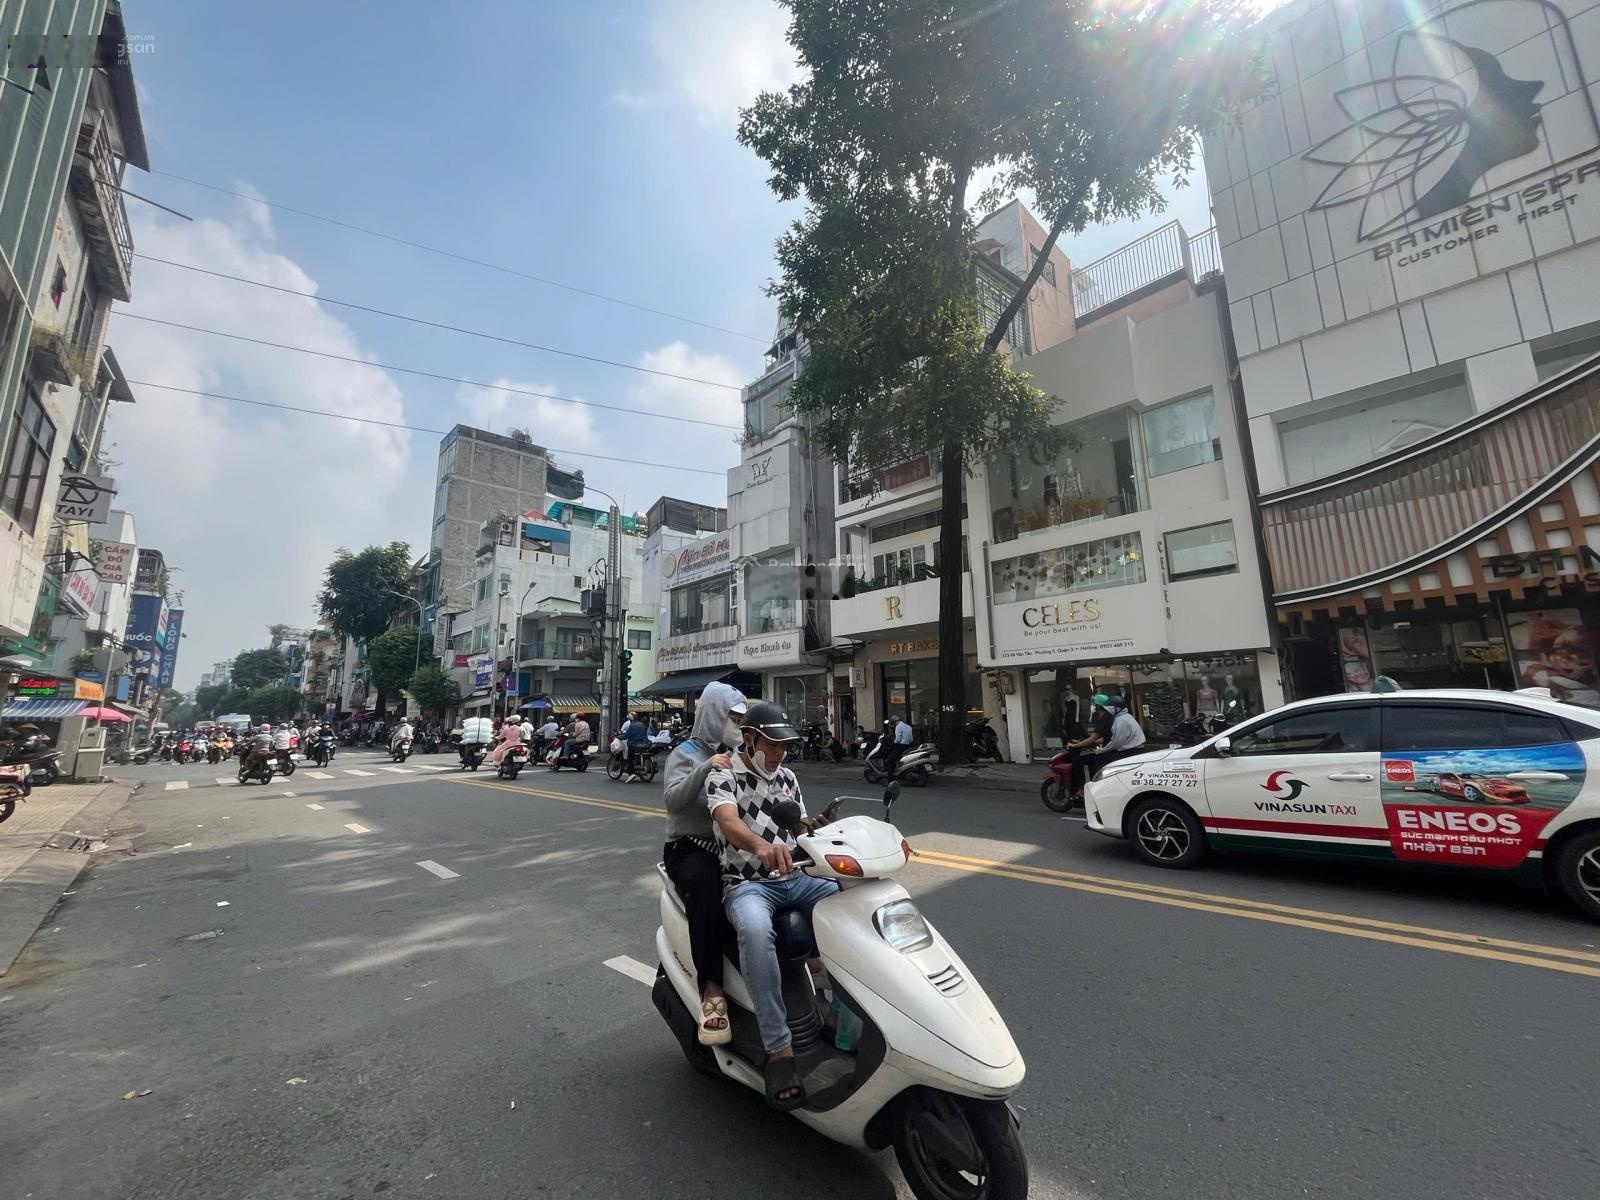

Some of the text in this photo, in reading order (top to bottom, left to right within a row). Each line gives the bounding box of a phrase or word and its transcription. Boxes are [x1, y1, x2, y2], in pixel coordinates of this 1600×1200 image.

[1397, 194, 1579, 267] CUSTOMER FIRST
[884, 595, 903, 621] R
[1022, 598, 1100, 628] CELES
[1035, 629, 1050, 638] your
[1053, 626, 1069, 634] best
[1071, 624, 1087, 632] with
[1254, 802, 1357, 815] VINASUN TAXI
[1397, 809, 1522, 835] ENEOS
